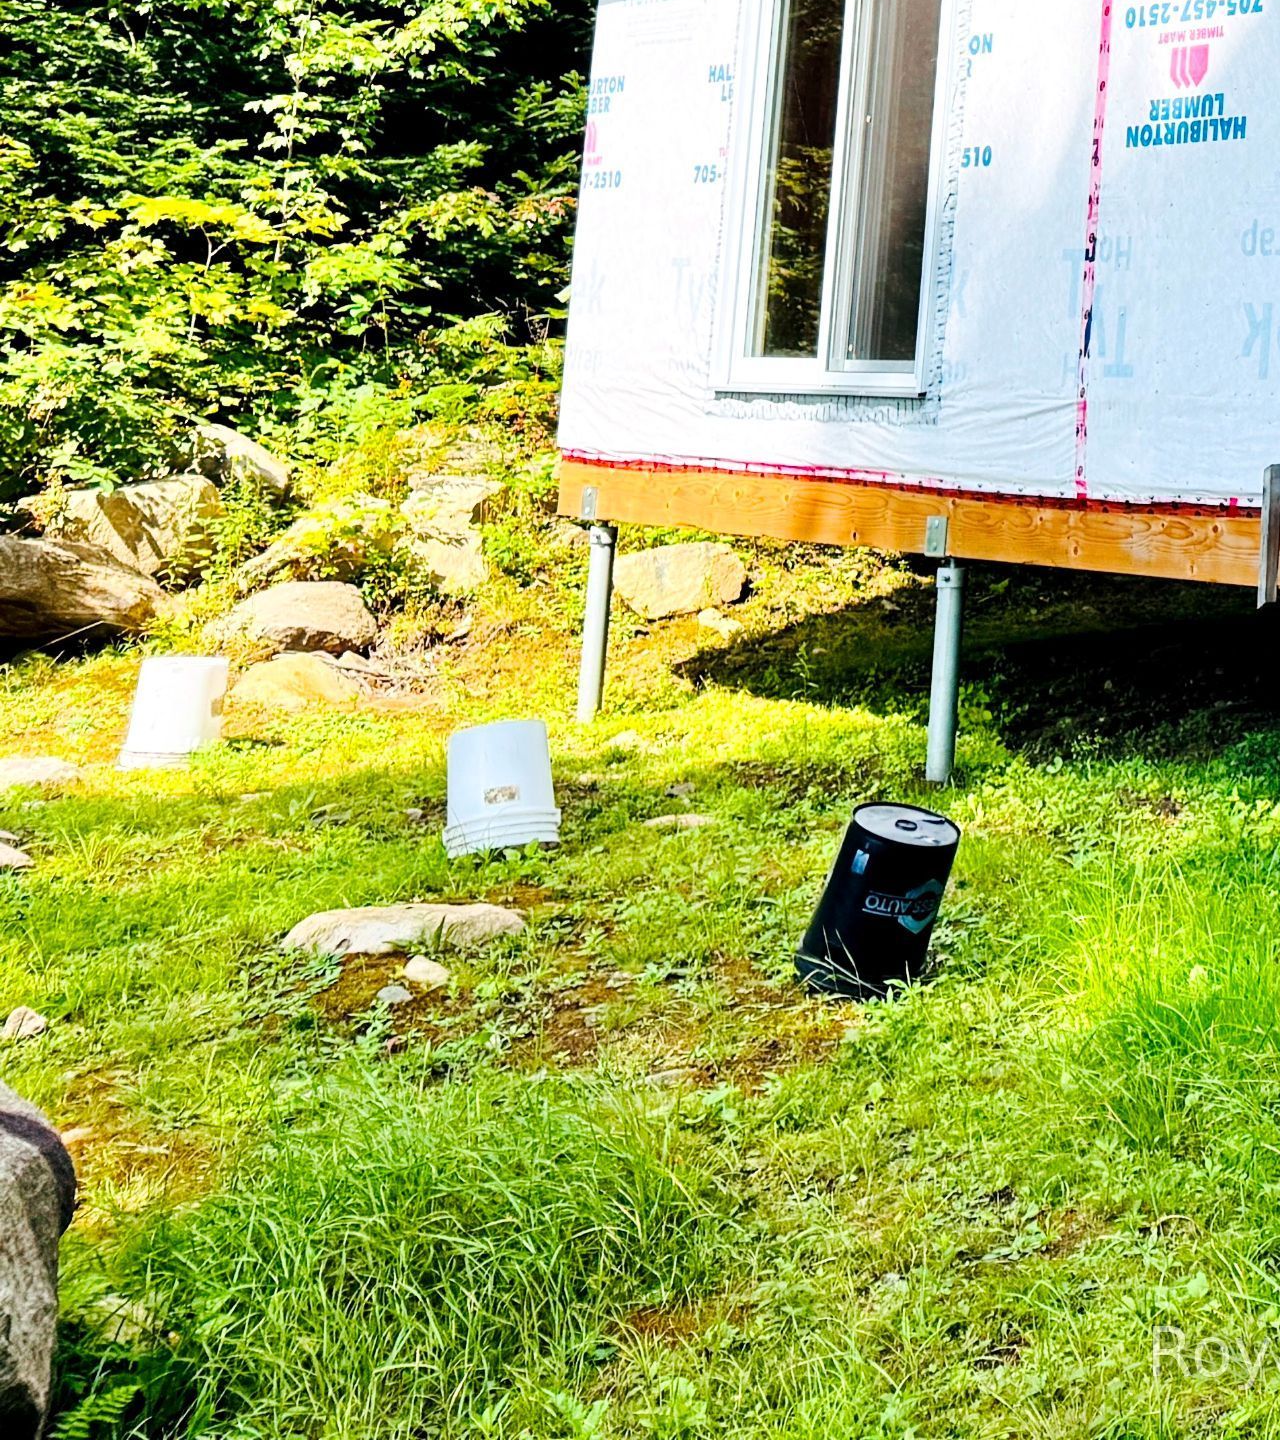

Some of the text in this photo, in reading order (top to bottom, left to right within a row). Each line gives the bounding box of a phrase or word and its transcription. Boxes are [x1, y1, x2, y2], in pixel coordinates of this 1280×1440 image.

[1158, 25, 1224, 44] TIMBER MART
[1150, 92, 1224, 121] LUMBER
[1126, 116, 1247, 148] HALIBURTON
[865, 895, 912, 914] AUTO
